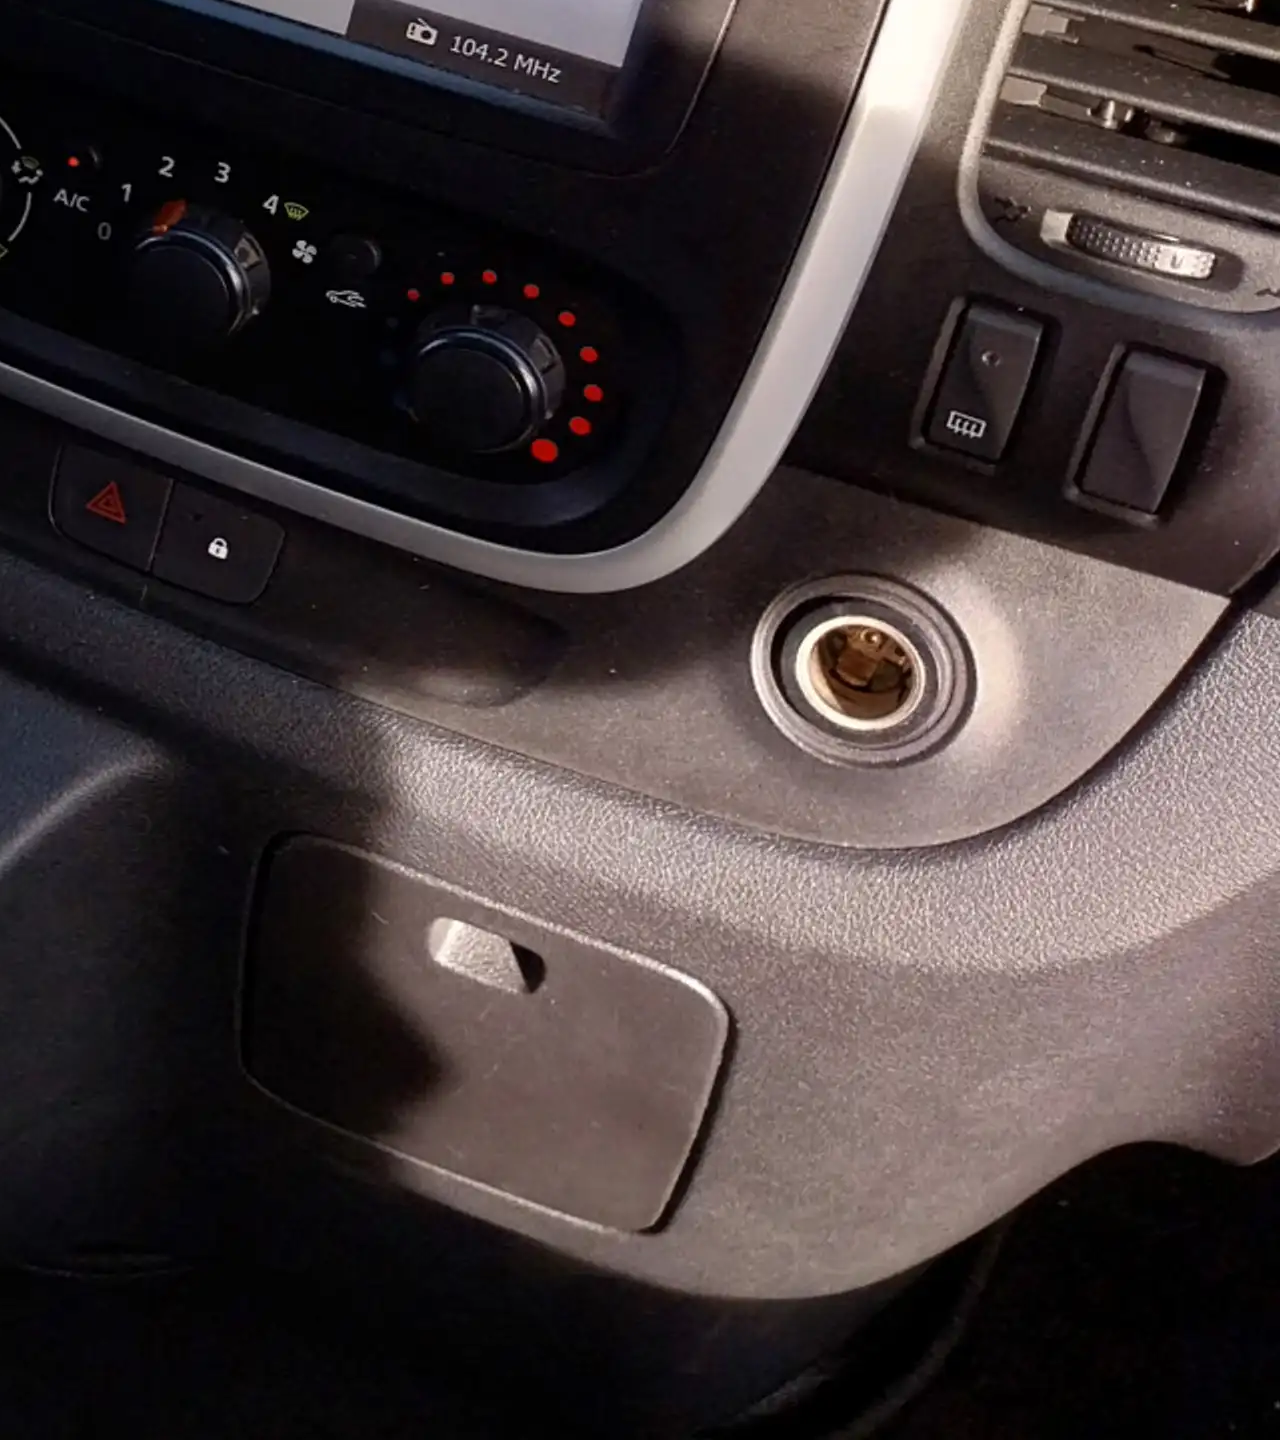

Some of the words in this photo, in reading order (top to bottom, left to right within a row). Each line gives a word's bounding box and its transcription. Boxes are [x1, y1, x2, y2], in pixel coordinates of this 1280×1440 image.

[450, 35, 509, 68] 104.2
[513, 53, 562, 84] MHz
[158, 156, 175, 178] 2
[214, 161, 231, 183] 3
[53, 188, 90, 213] A/C
[121, 183, 133, 203] 1
[262, 194, 280, 216] 4
[97, 221, 112, 241] 0
